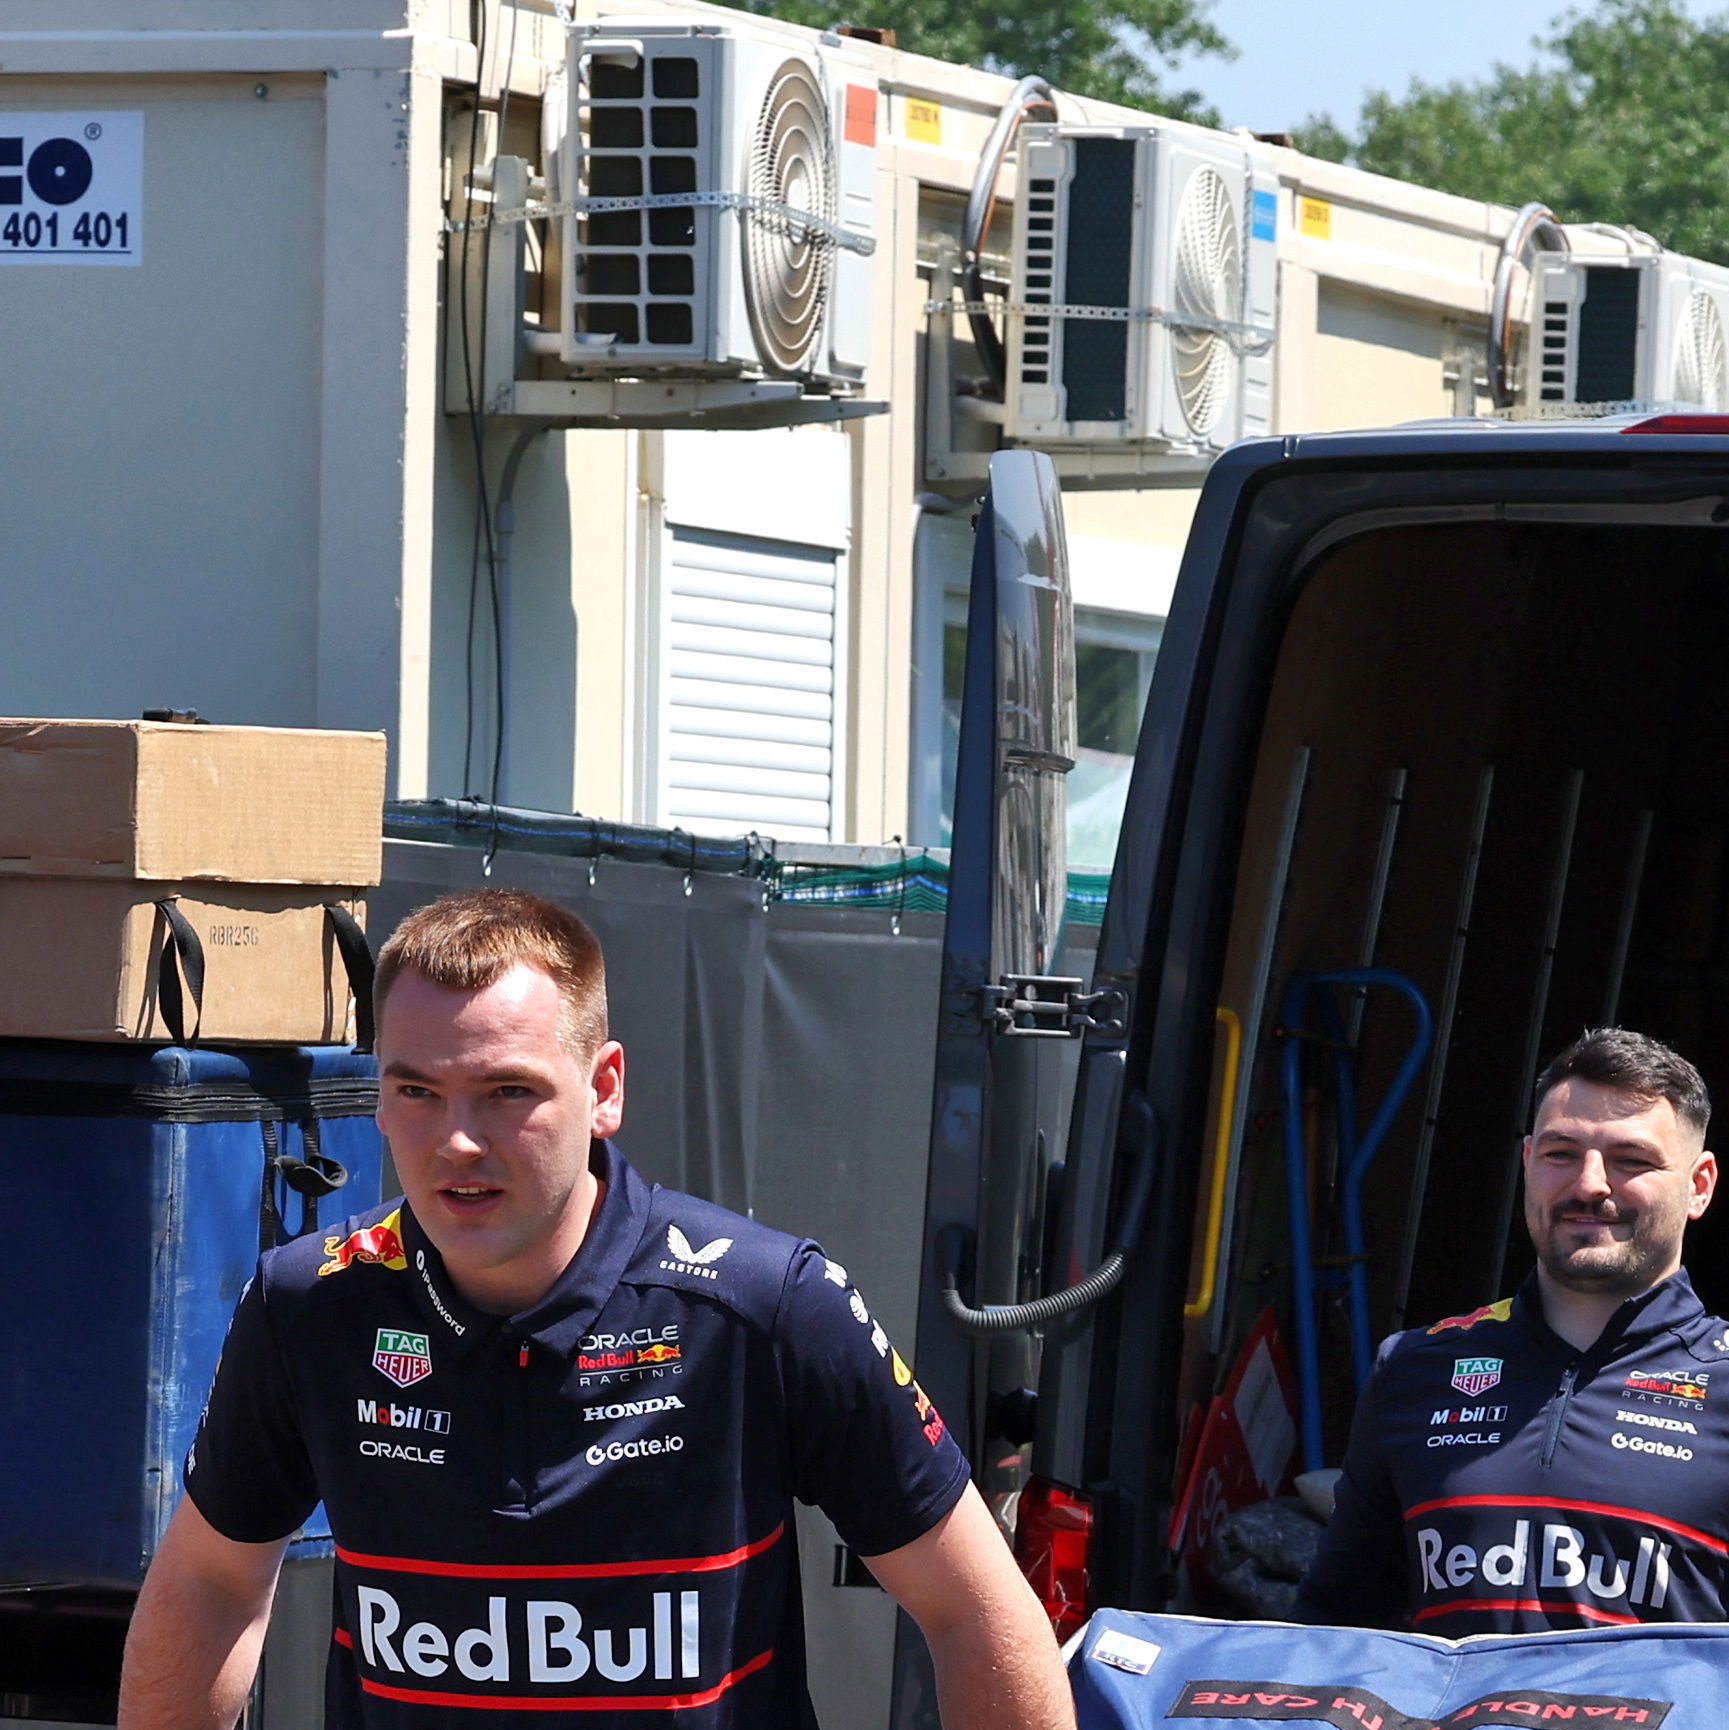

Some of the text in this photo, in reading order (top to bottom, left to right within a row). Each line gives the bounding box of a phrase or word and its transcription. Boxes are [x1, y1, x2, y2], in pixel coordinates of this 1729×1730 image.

[3, 211, 59, 248] 401
[73, 211, 129, 248] 401
[659, 1260, 719, 1280] CASTORE
[383, 1332, 425, 1354] TAG
[578, 1325, 679, 1350] ORACLE
[377, 1355, 430, 1382] HEUER
[578, 1350, 635, 1369] Red Bull
[1459, 1360, 1498, 1374] TAG
[579, 1364, 683, 1387] RACING
[1454, 1374, 1499, 1393] HEUER
[583, 1395, 685, 1421] HONDA
[1622, 1390, 1703, 1411] RACING
[357, 1399, 422, 1429] Mobil
[1430, 1406, 1486, 1425] Mobil
[1616, 1410, 1697, 1435] HONDA
[1427, 1432, 1501, 1448] ORACLE
[359, 1441, 446, 1465] ORACLE
[1417, 1519, 1672, 1609] Red Bull
[358, 1585, 700, 1682] Red Bull
[1191, 1691, 1319, 1709] CARE
[1452, 1699, 1649, 1724] HANDLE
